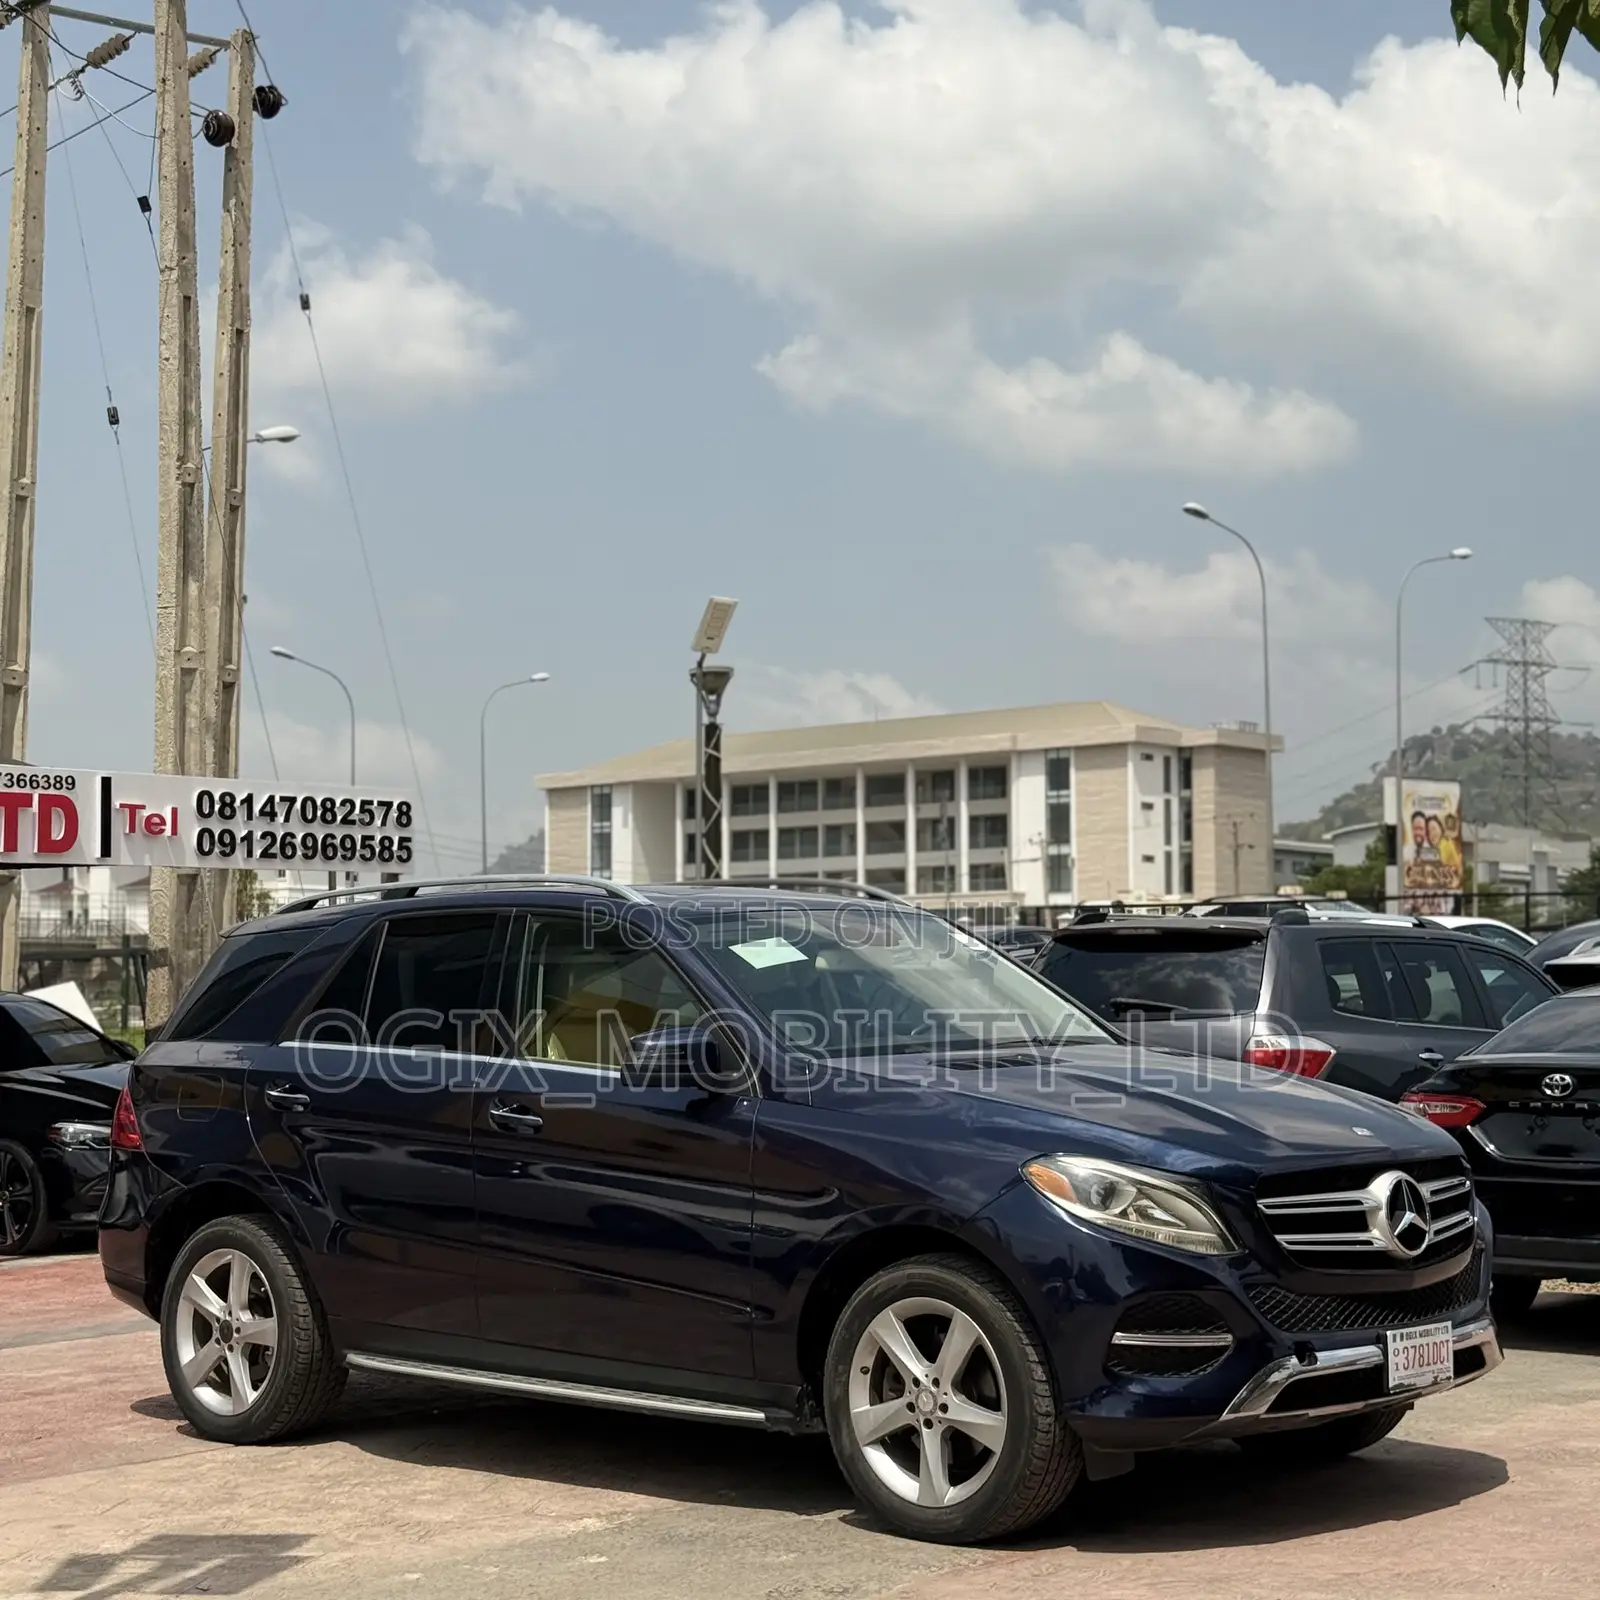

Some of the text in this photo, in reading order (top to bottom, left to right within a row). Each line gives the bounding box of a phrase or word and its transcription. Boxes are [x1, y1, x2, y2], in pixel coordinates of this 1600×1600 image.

[0, 773, 76, 791] 366389
[0, 792, 79, 854] TD
[118, 802, 179, 836] Tel
[196, 789, 412, 828] 08147082578
[196, 827, 412, 863] 09126969585
[1508, 1101, 1600, 1109] CAMR
